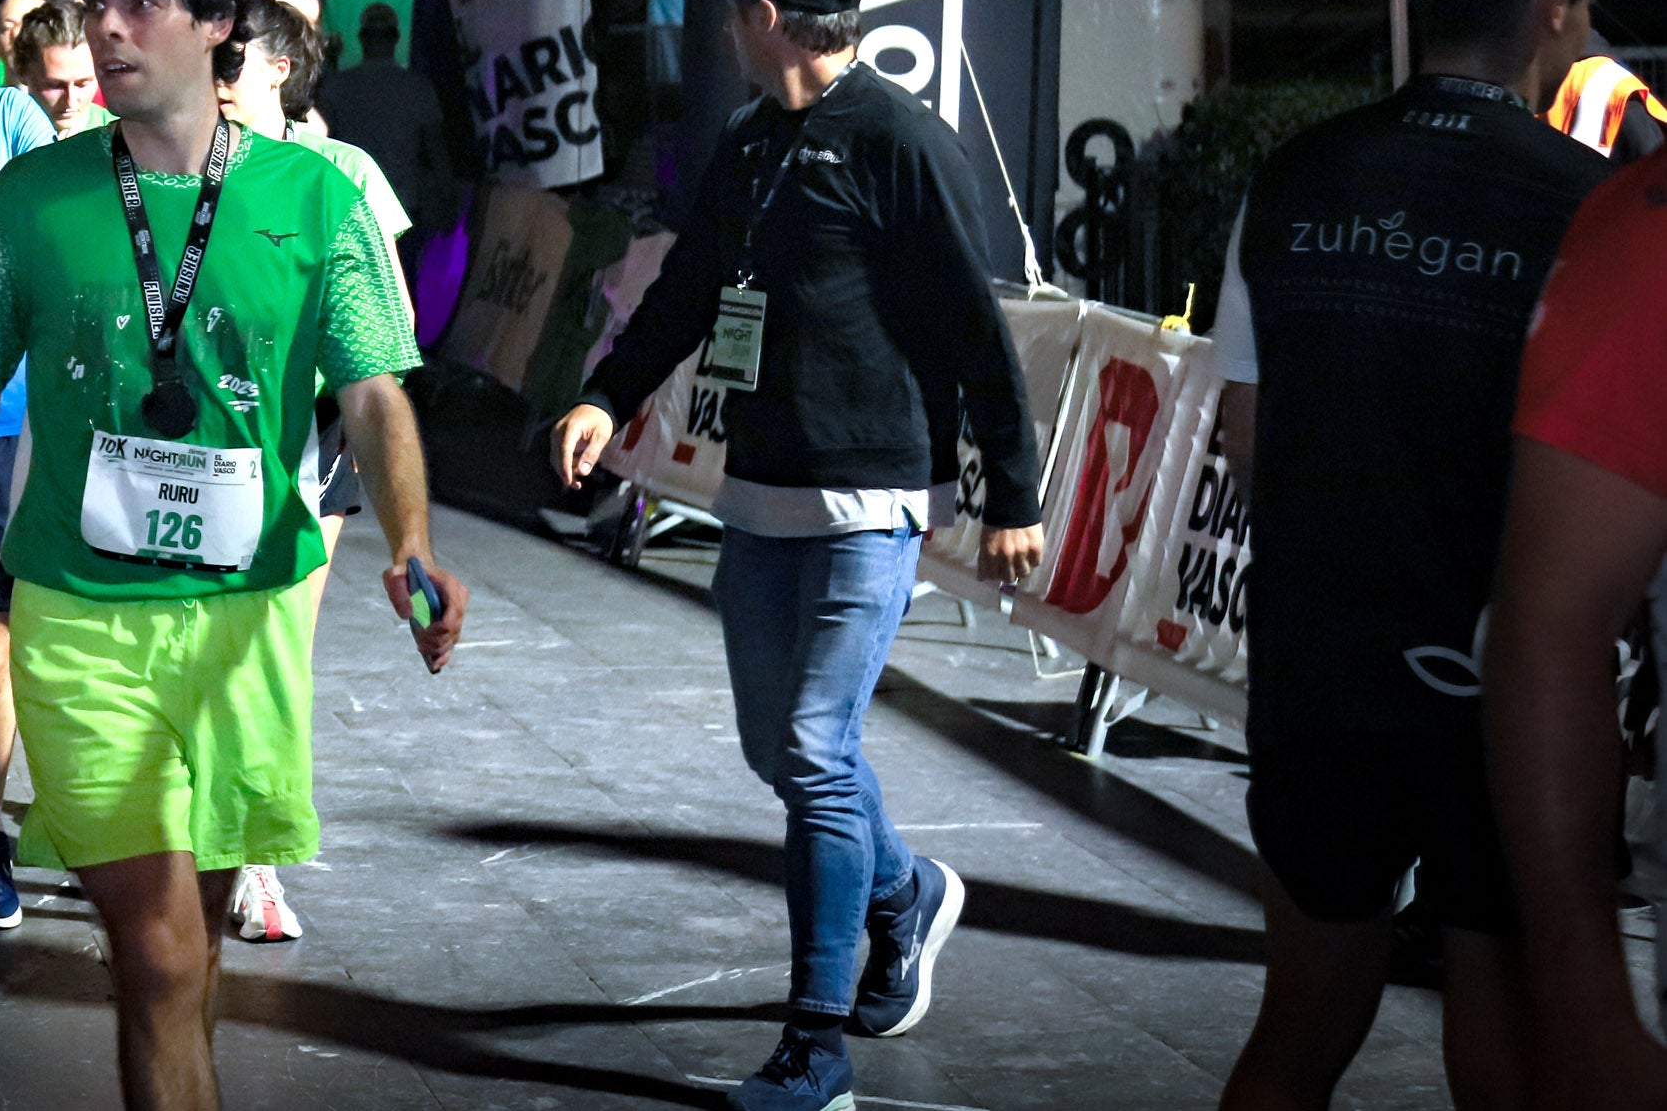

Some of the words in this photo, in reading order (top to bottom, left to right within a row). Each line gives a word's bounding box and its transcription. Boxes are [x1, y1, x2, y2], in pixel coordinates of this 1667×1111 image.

[207, 125, 229, 182] FINISHER
[115, 154, 142, 208] FINISHER
[1289, 211, 1521, 281] zuhegan
[171, 245, 203, 304] FINISHER
[143, 280, 166, 340] FINISHE
[216, 373, 260, 398] 2025
[99, 437, 128, 460] 10K
[213, 460, 237, 468] DIARIO
[214, 454, 223, 462] EL
[213, 467, 237, 475] VASCO
[249, 460, 258, 479] 2
[158, 482, 200, 504] RURU
[145, 509, 203, 550] 126
[1177, 542, 1253, 633] VASC
